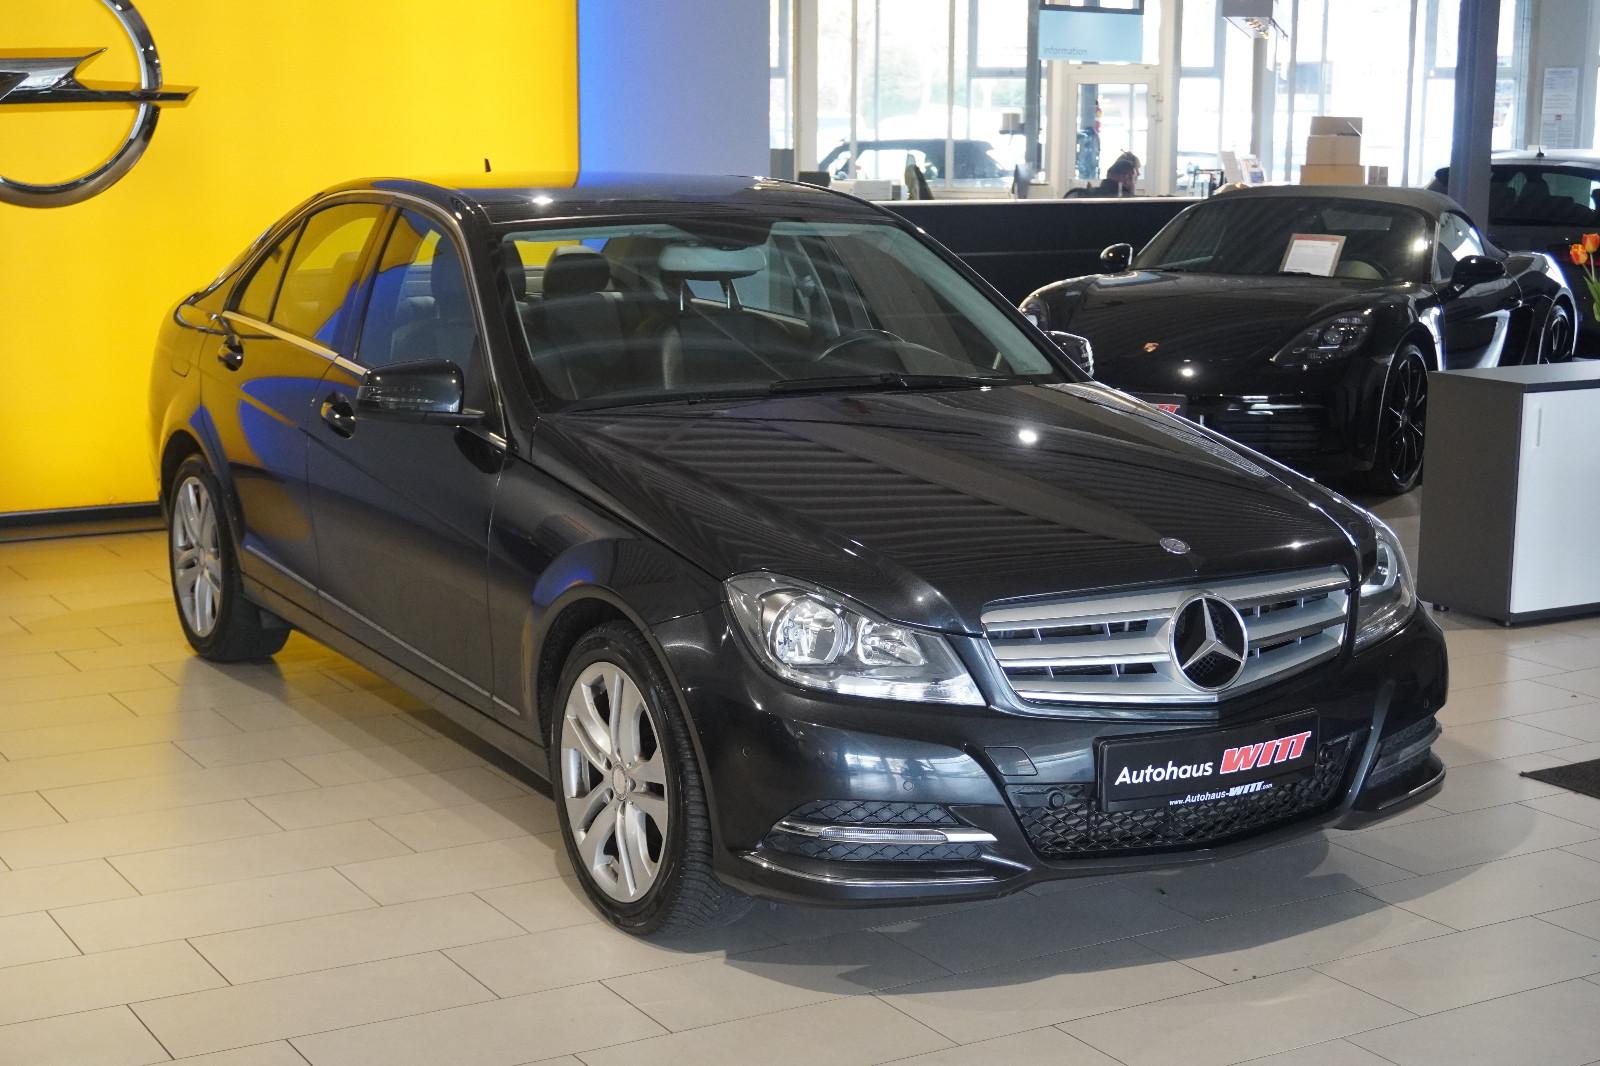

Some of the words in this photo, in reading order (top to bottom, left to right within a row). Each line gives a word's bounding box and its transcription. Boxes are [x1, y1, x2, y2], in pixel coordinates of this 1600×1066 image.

[1114, 761, 1213, 786] Autohaus
[1219, 731, 1311, 774] WITT
[1169, 781, 1273, 806] www.Autohaus-WITT.com
